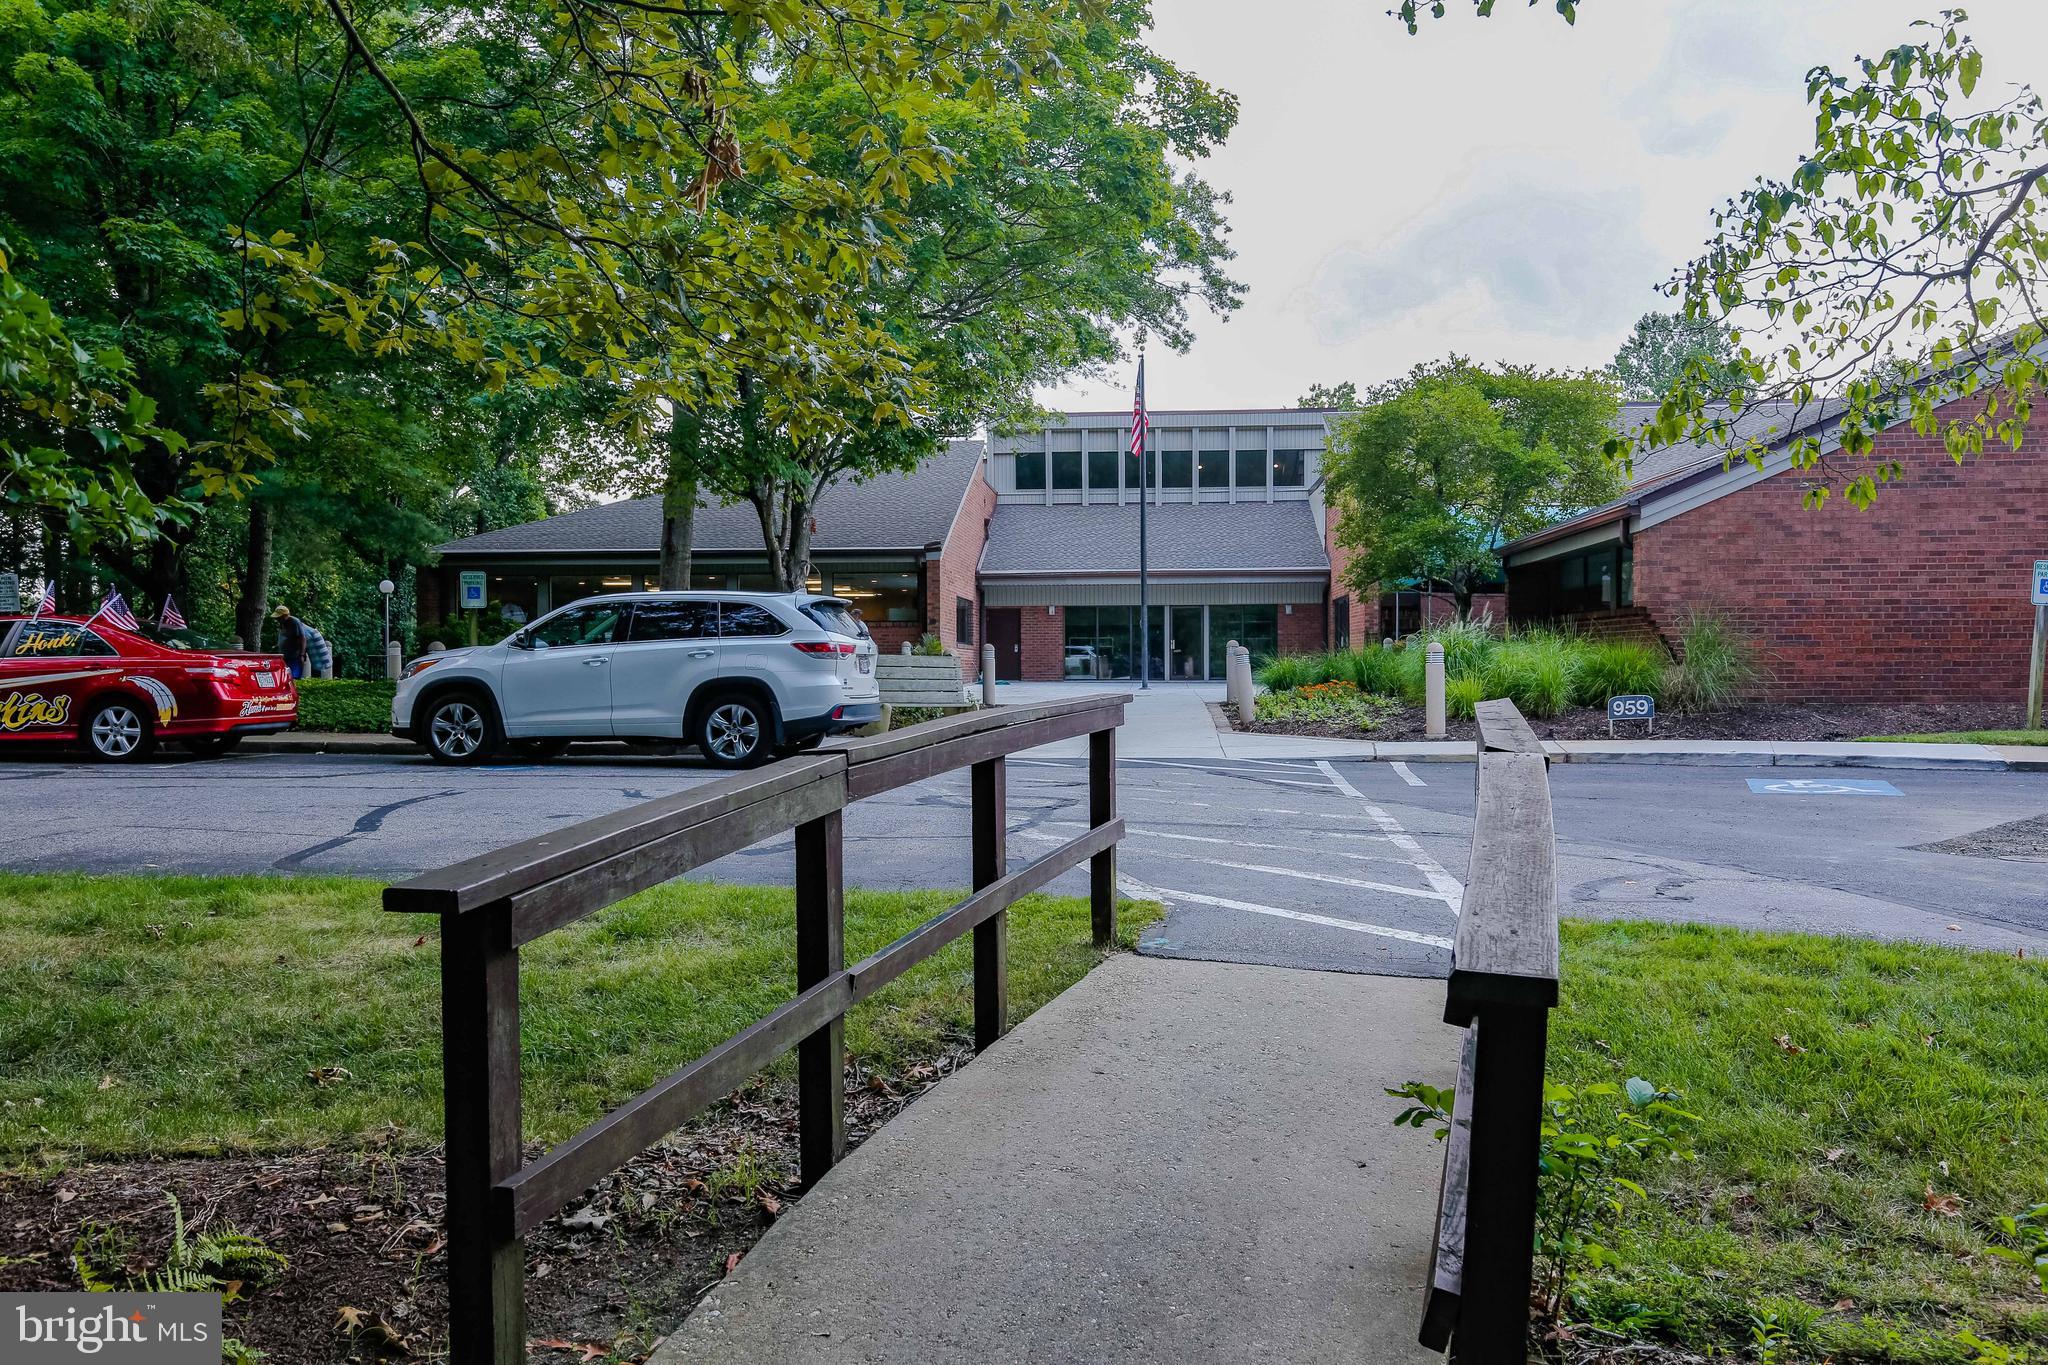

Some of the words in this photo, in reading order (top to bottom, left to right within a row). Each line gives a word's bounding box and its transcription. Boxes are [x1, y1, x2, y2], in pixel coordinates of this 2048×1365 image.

[16, 632, 80, 654] Honk!
[0, 692, 70, 729] kins
[1612, 700, 1649, 715] 959
